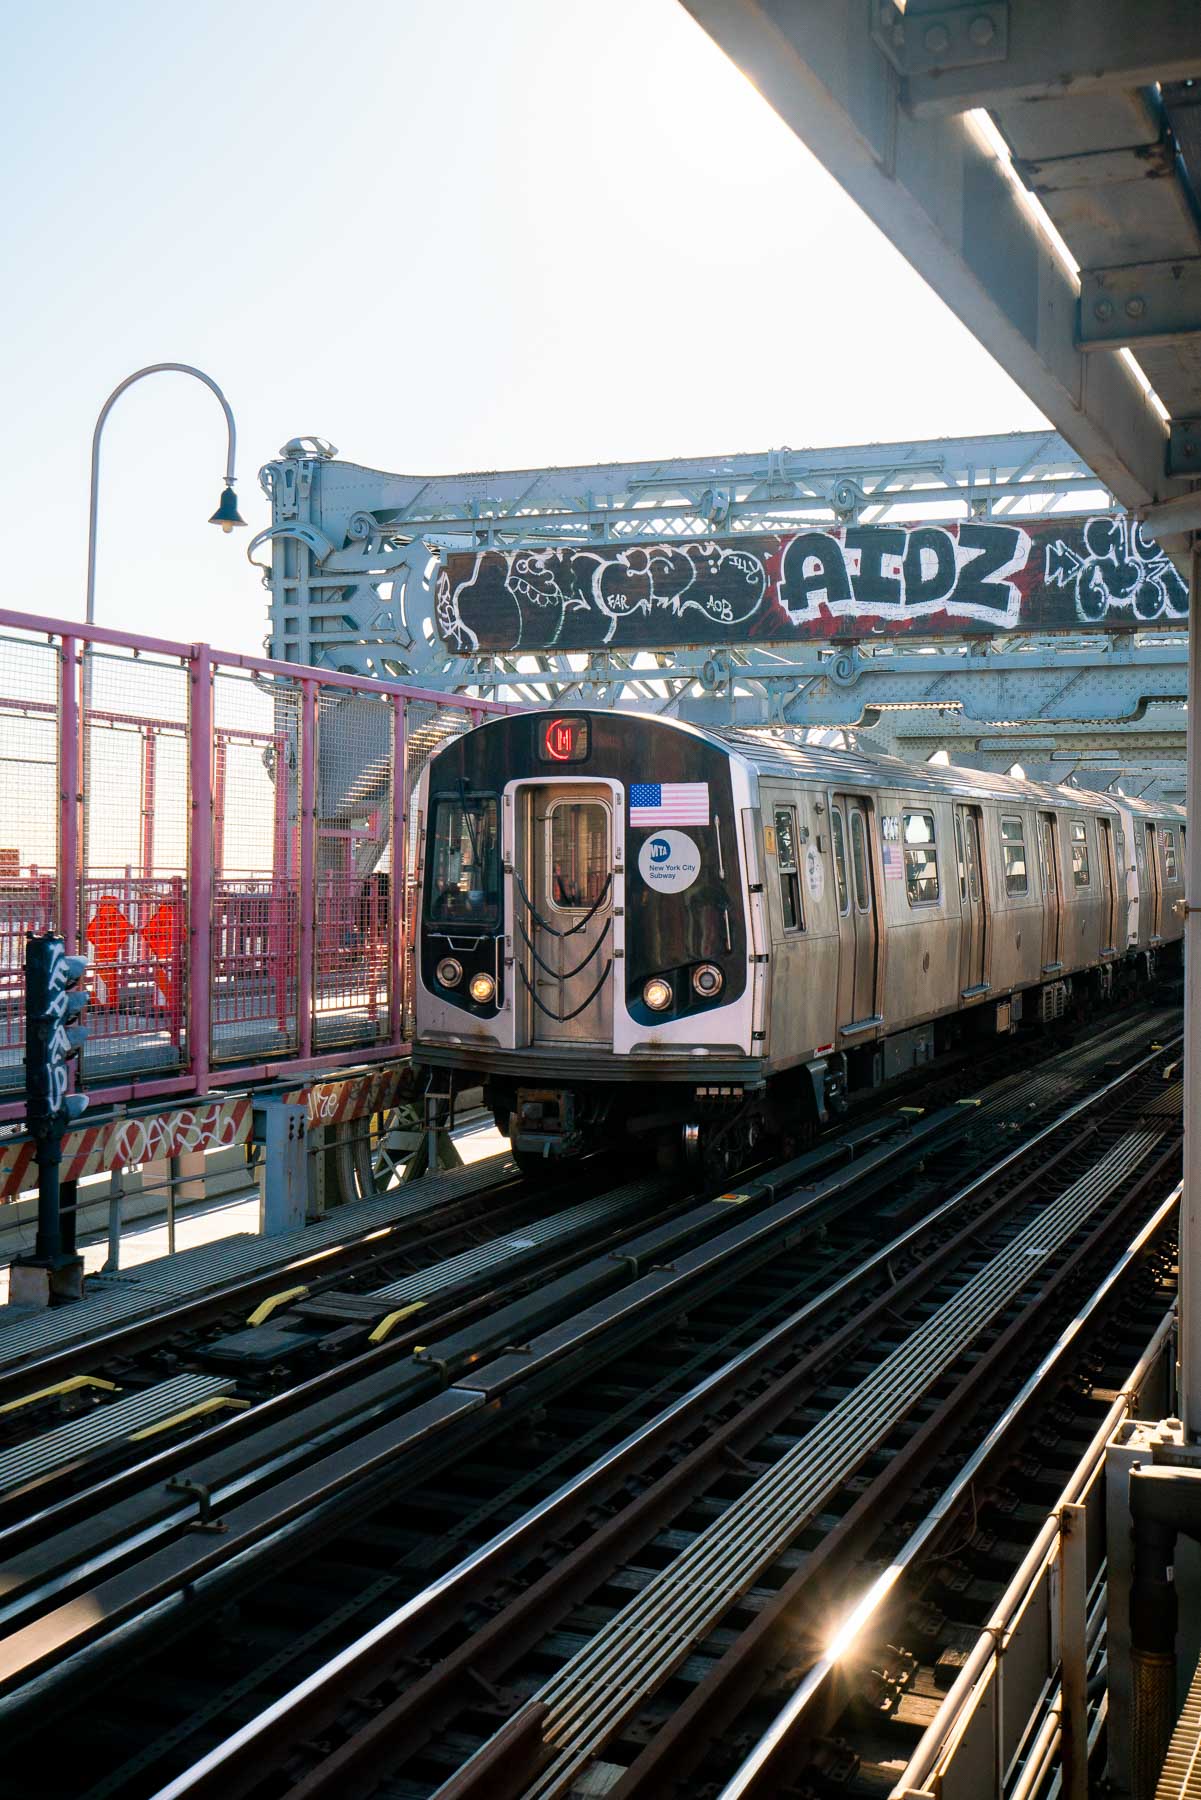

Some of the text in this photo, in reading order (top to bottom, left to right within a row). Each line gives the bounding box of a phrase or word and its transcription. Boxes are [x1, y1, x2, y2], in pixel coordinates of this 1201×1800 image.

[777, 520, 1032, 629] AIDZ
[607, 594, 629, 610] FAR
[648, 844, 668, 858] MTA
[682, 864, 696, 872] City
